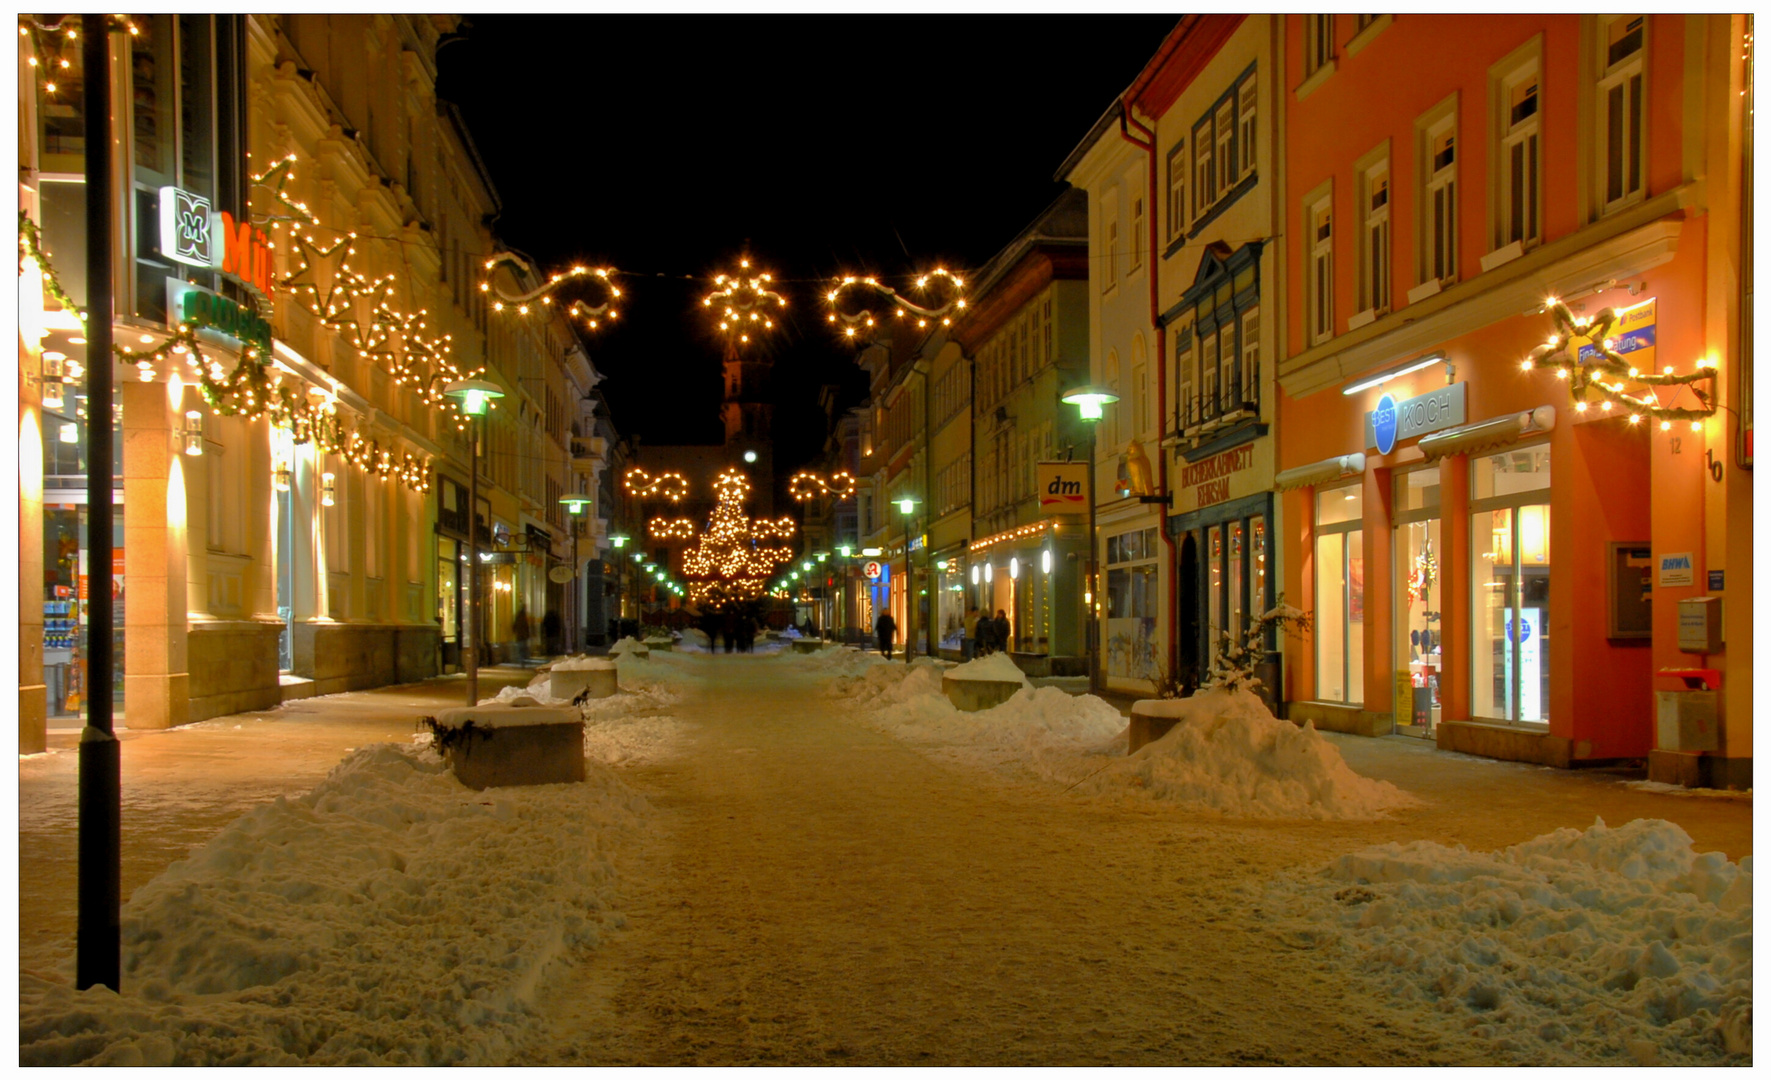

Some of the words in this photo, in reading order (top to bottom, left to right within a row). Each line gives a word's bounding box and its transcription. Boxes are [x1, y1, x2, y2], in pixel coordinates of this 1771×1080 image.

[1629, 309, 1653, 322] Postbank
[1372, 407, 1396, 428] BEST
[1404, 393, 1451, 432] KOCH
[1669, 437, 1682, 455] 12
[1705, 448, 1723, 483] 10
[1048, 475, 1081, 495] dm
